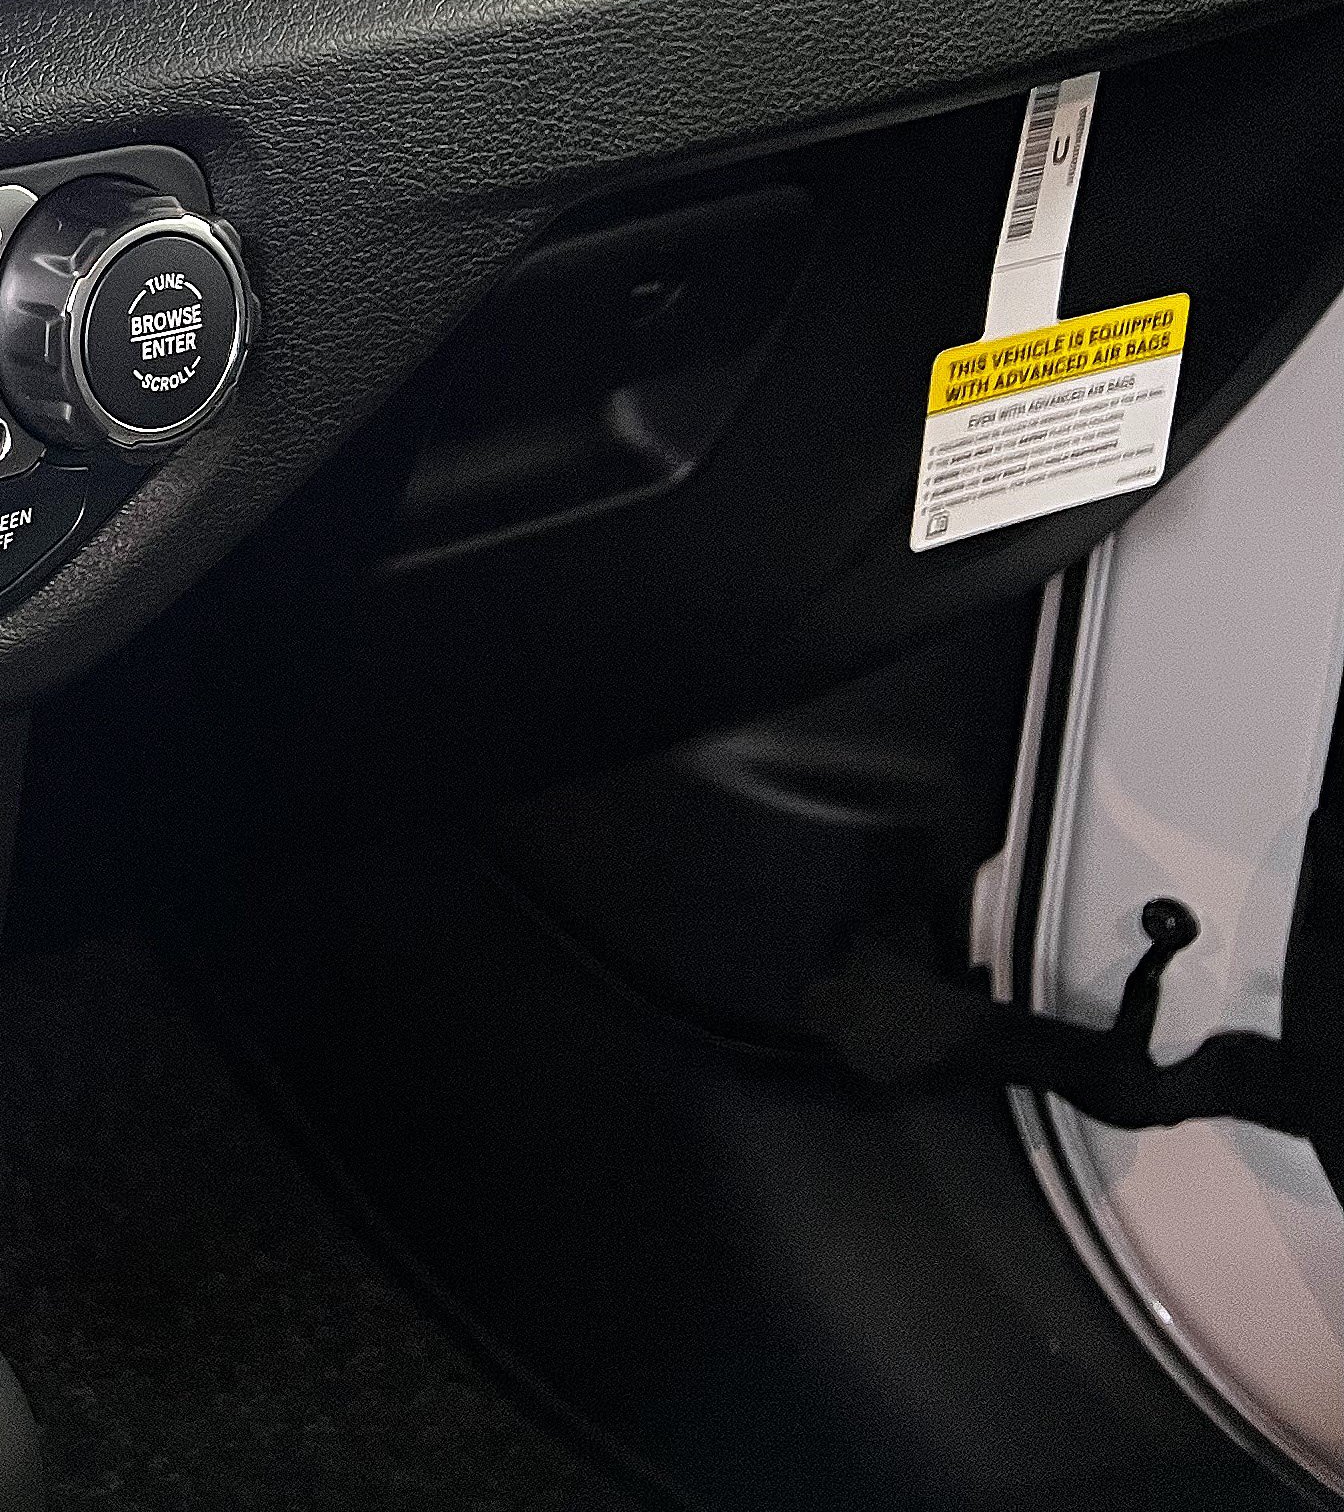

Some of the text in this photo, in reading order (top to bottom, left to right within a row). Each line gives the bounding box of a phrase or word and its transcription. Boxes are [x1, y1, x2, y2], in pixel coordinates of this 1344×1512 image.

[145, 272, 185, 295] TUNE
[131, 304, 202, 336] BROWSE
[142, 332, 197, 361] ENTER
[949, 309, 1174, 380] THIS VEHICLE IS EQUIPPED
[141, 366, 196, 392] SCROLL
[946, 331, 1171, 402] WITH ADVANCED AIR BAGS
